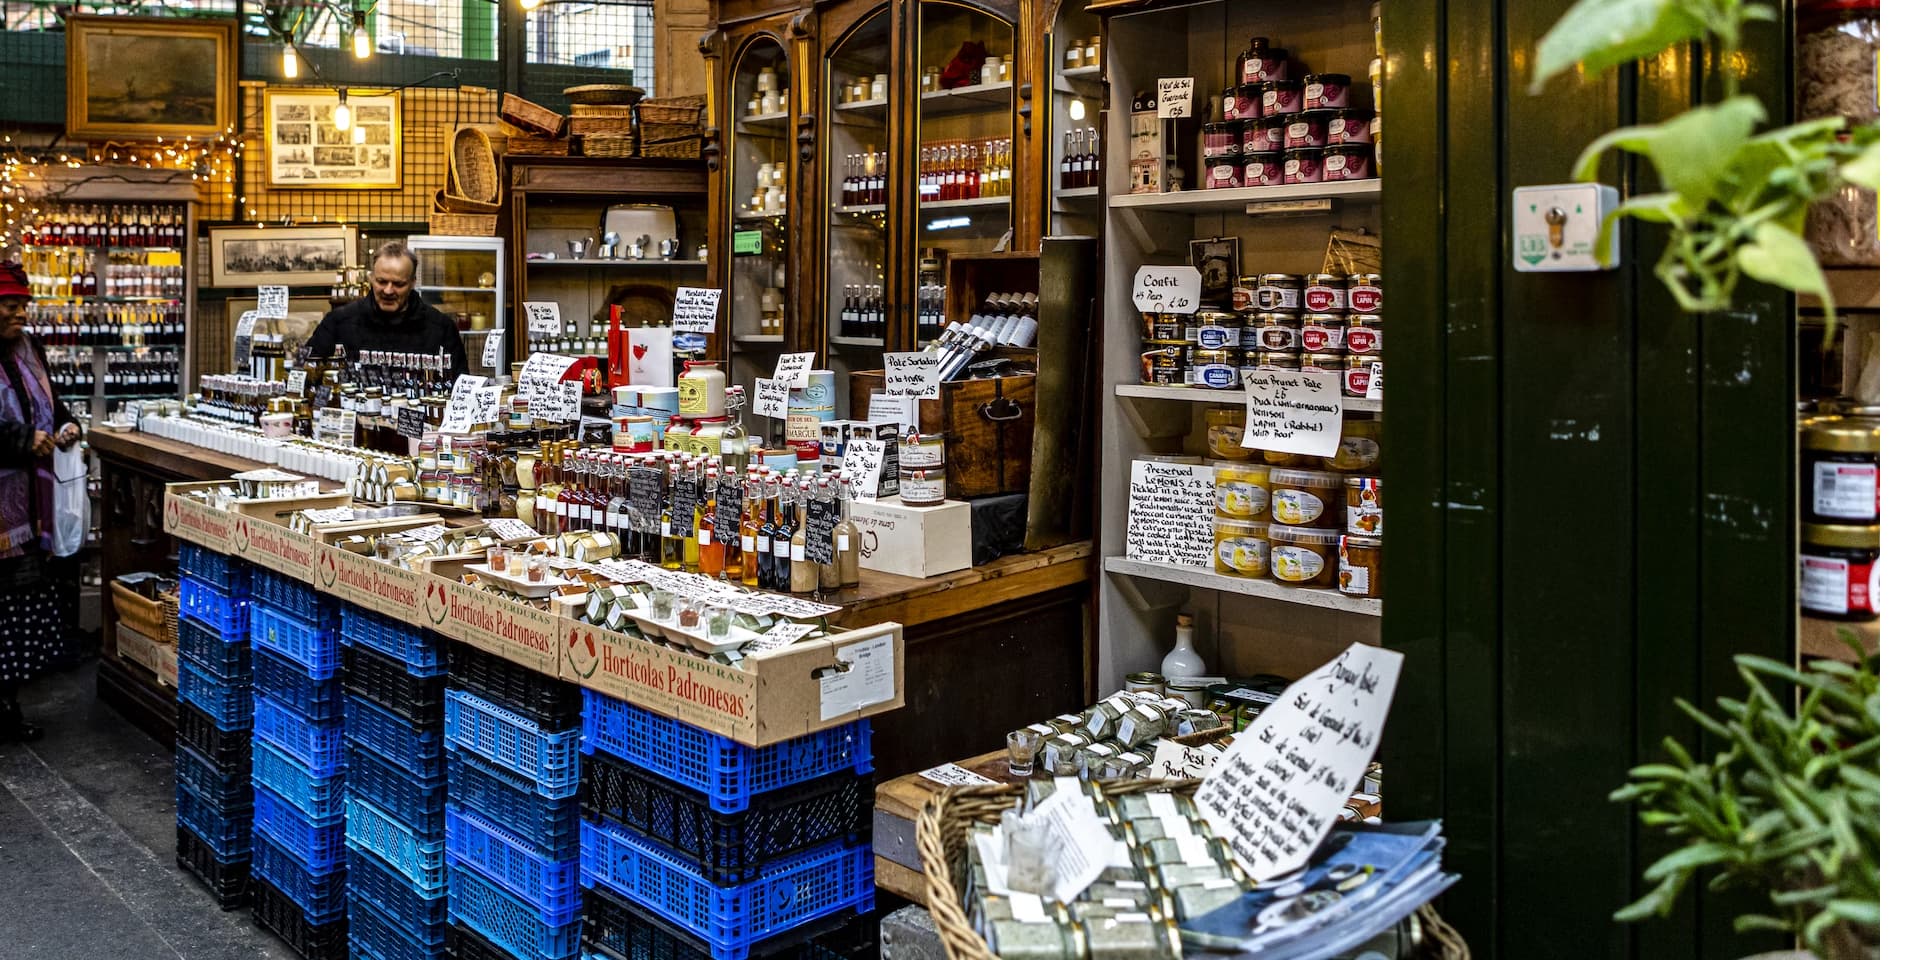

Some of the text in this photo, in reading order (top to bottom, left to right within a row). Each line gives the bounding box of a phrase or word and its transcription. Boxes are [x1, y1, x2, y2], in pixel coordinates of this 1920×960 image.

[1143, 274, 1179, 287] Confit
[1311, 296, 1326, 304] LAPIN
[1357, 296, 1372, 304] LAPIN
[1305, 335, 1320, 343] LAPIN
[1352, 337, 1367, 345] LAPIN
[1269, 374, 1300, 387] Brunet
[1143, 463, 1193, 476] Preserved
[1188, 478, 1202, 488] £8
[1205, 490, 1216, 498] of
[373, 571, 415, 607] Padronesas
[451, 583, 485, 601] FRUTAS
[451, 594, 550, 653] Hortícolas Padronesas
[602, 632, 651, 655] FRUTAS
[669, 653, 745, 685] VERDURAS
[602, 644, 665, 692] Hortícolas
[667, 665, 745, 719] Padronesas
[1183, 747, 1205, 766] Best
